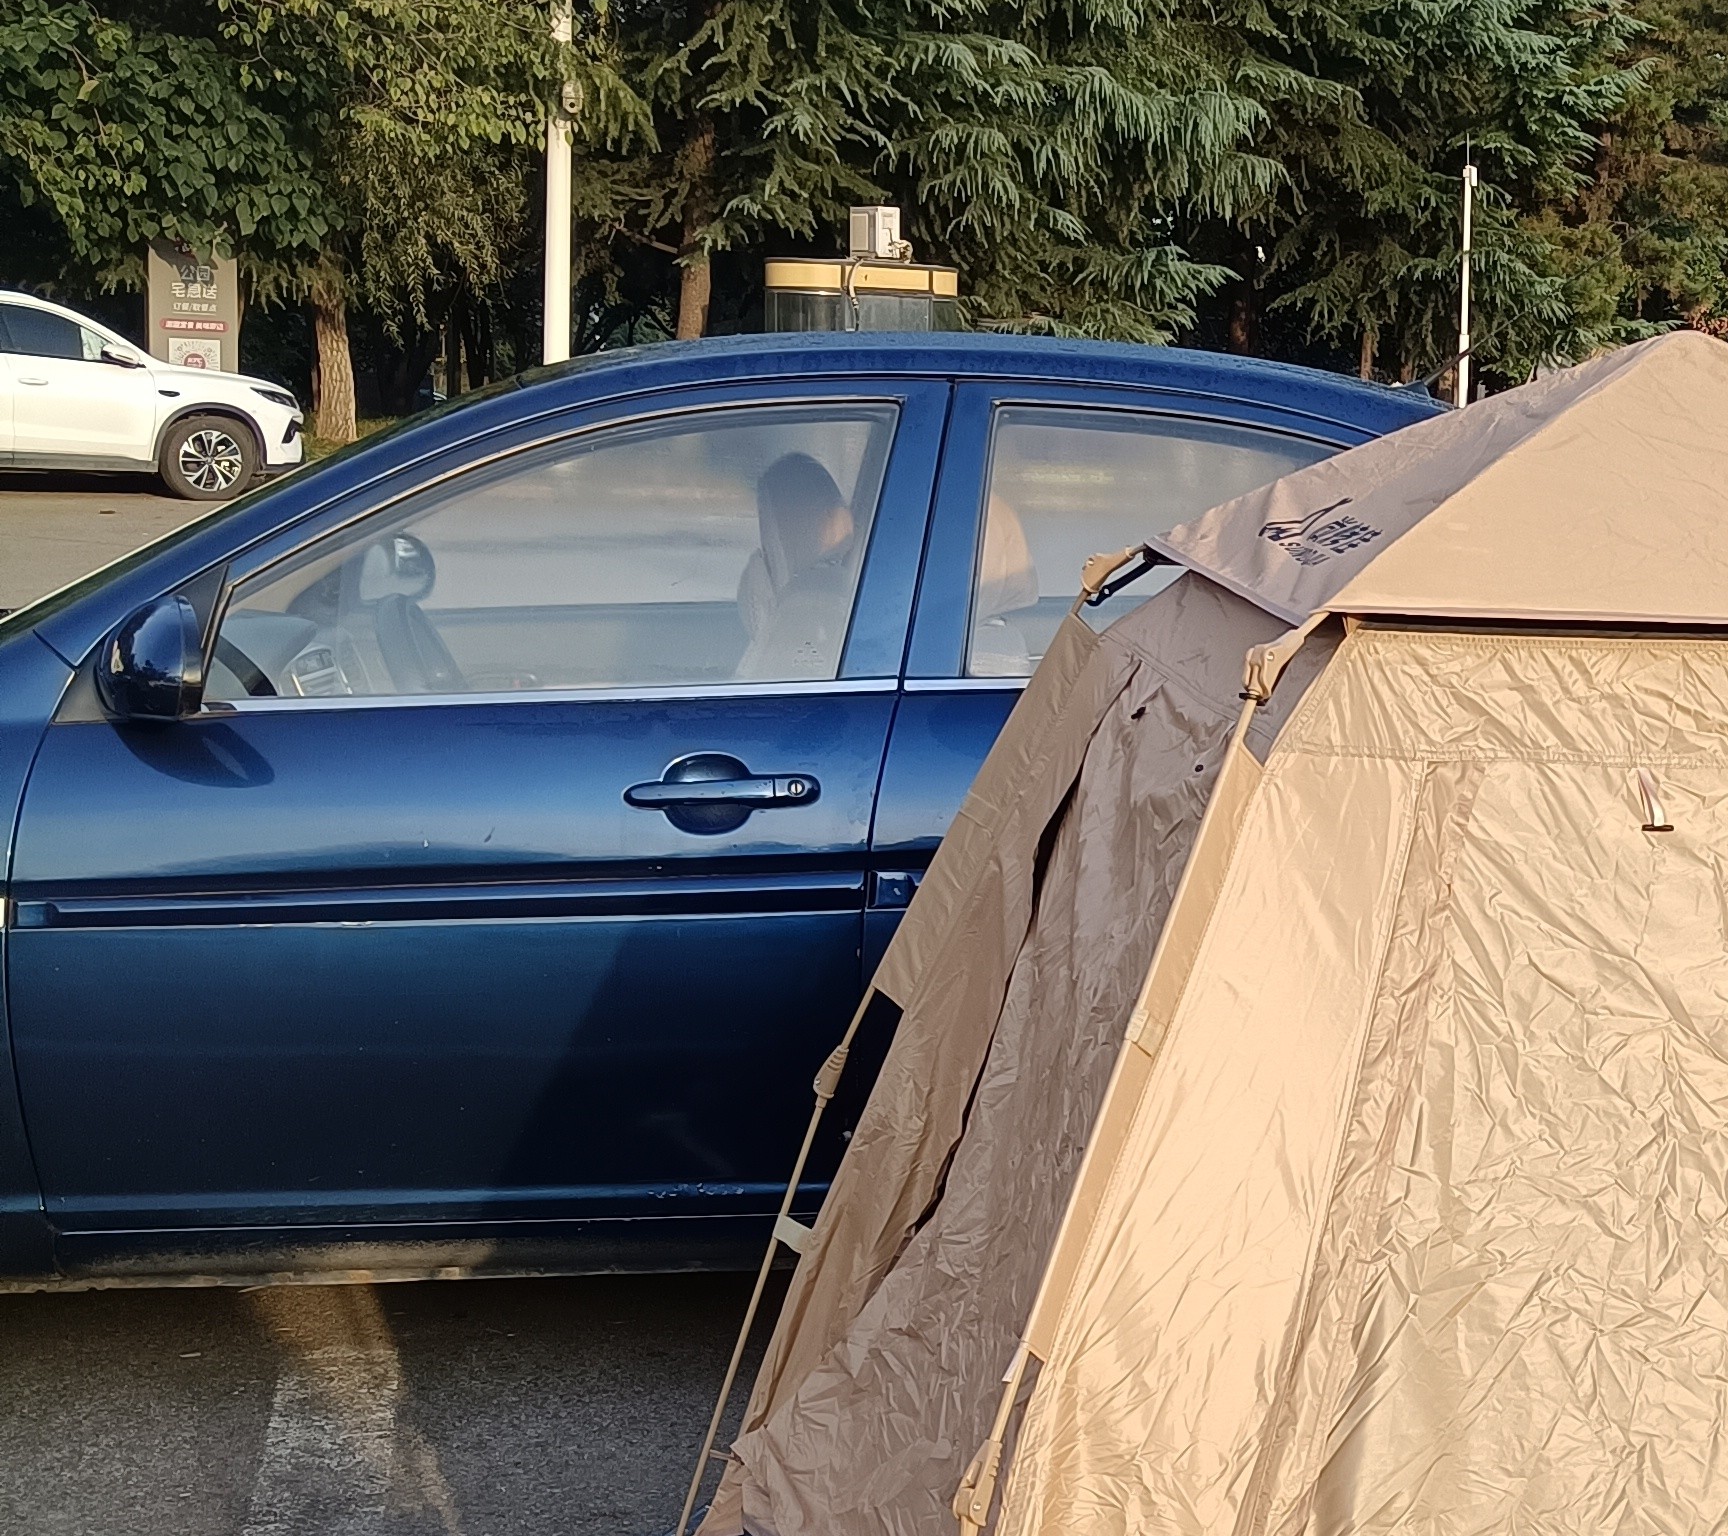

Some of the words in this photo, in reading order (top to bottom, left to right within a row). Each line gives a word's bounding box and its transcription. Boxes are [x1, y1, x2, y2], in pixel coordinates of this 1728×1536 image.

[180, 264, 211, 281] 公园
[171, 282, 217, 299] 宅急送
